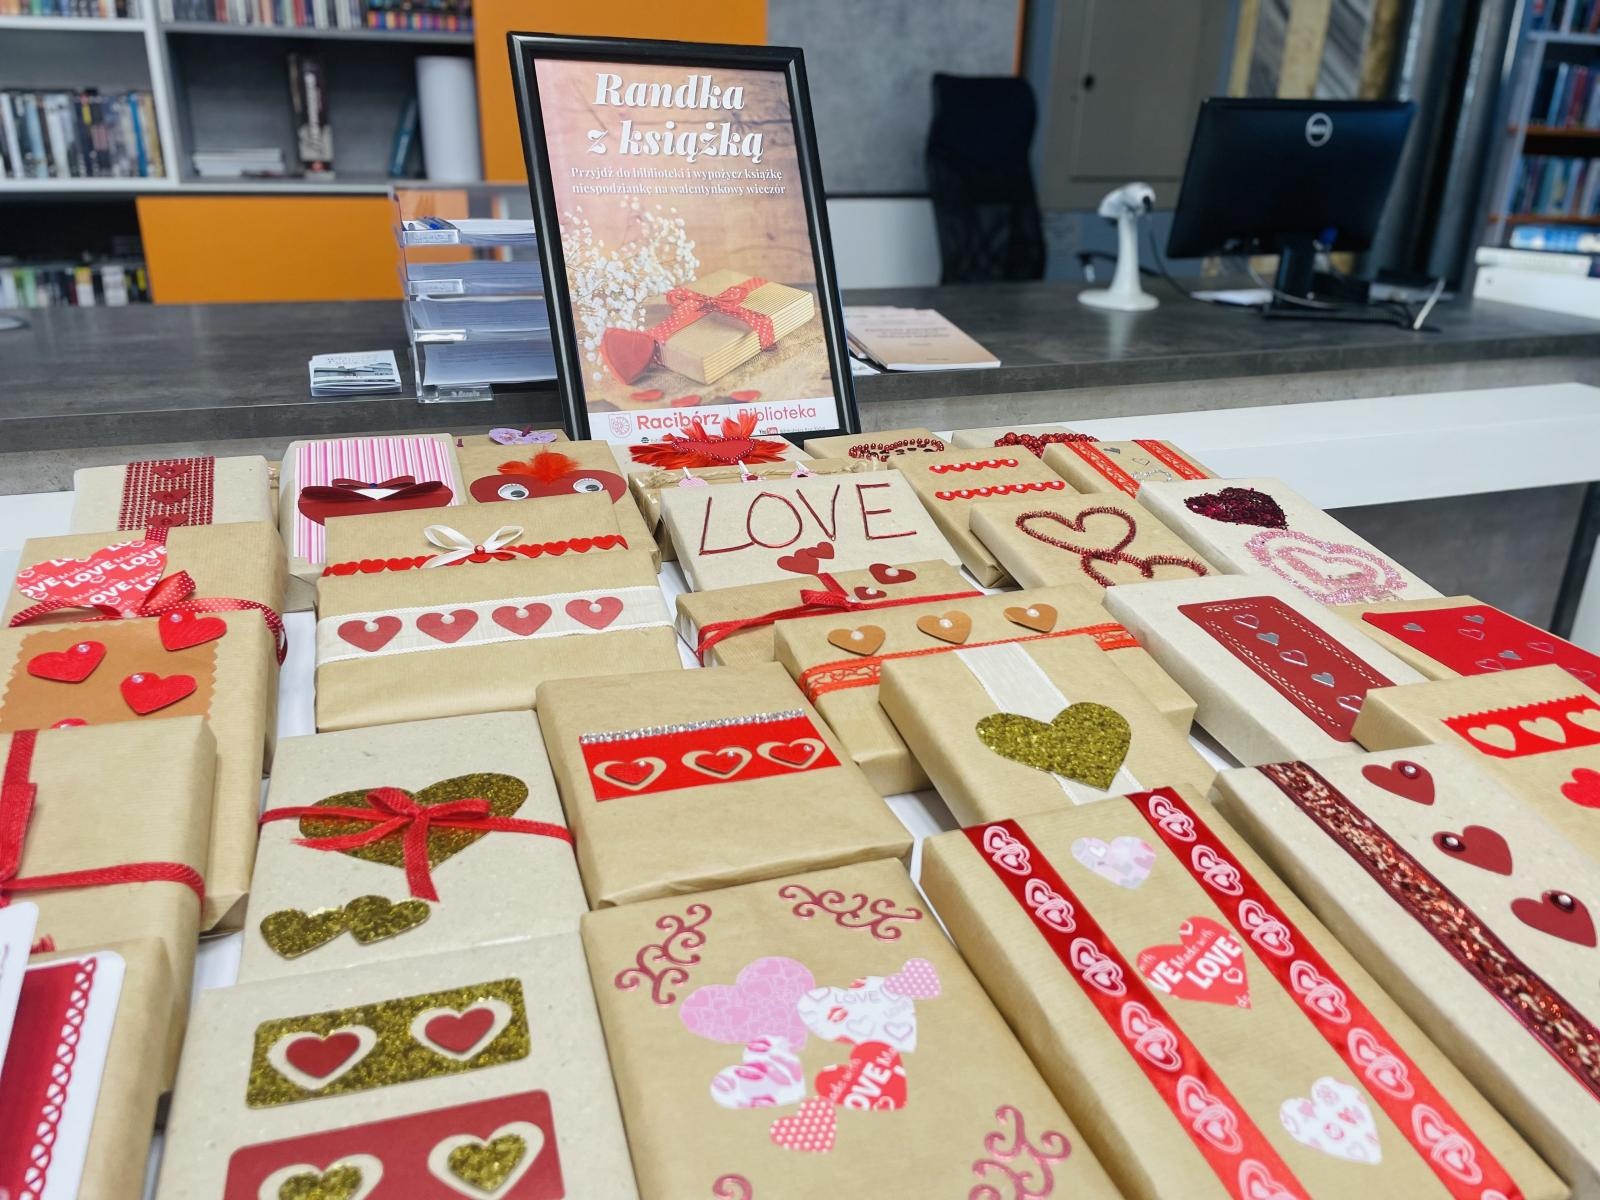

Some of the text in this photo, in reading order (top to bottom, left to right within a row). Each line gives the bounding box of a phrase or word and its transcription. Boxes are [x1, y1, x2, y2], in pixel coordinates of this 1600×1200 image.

[592, 73, 745, 110] Randka
[587, 120, 764, 164] z książką
[571, 167, 613, 180] Przyjdź
[616, 167, 630, 178] do
[632, 167, 685, 179] biblioteki
[694, 168, 742, 182] wypożycz
[744, 168, 783, 181] książkę
[572, 183, 786, 196] niespodziankę na walentynkowy wieczór
[636, 411, 721, 430] Racibórz
[699, 484, 918, 555] LOVE
[120, 545, 168, 571] LOVE
[64, 560, 116, 588] LOVE
[1185, 936, 1242, 990] LOVE
